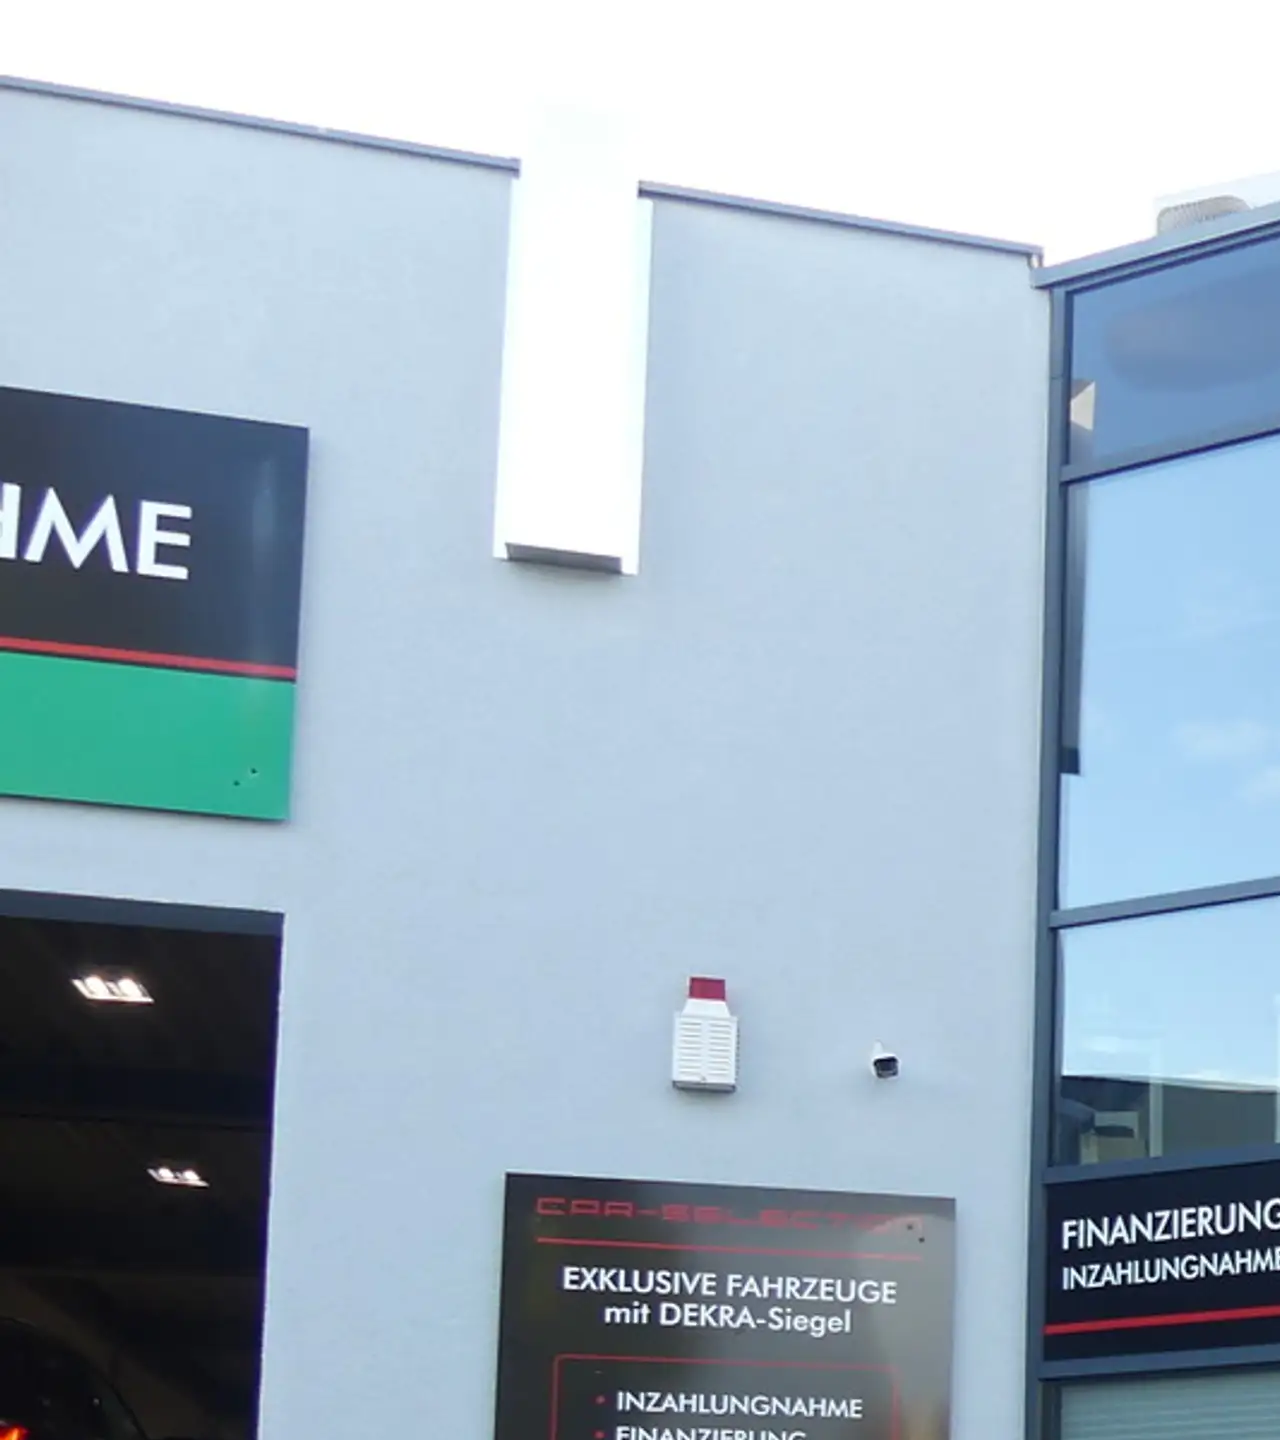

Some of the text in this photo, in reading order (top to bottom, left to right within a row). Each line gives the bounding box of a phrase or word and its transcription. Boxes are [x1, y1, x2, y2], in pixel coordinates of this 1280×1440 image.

[535, 1197, 924, 1234] CAR-SELECT
[563, 1266, 898, 1304] EXKLUSIVE FAHRZEUGE
[604, 1303, 853, 1338] mit DEKRA-Siegel
[616, 1391, 864, 1420] INZAHLUNGNAHME
